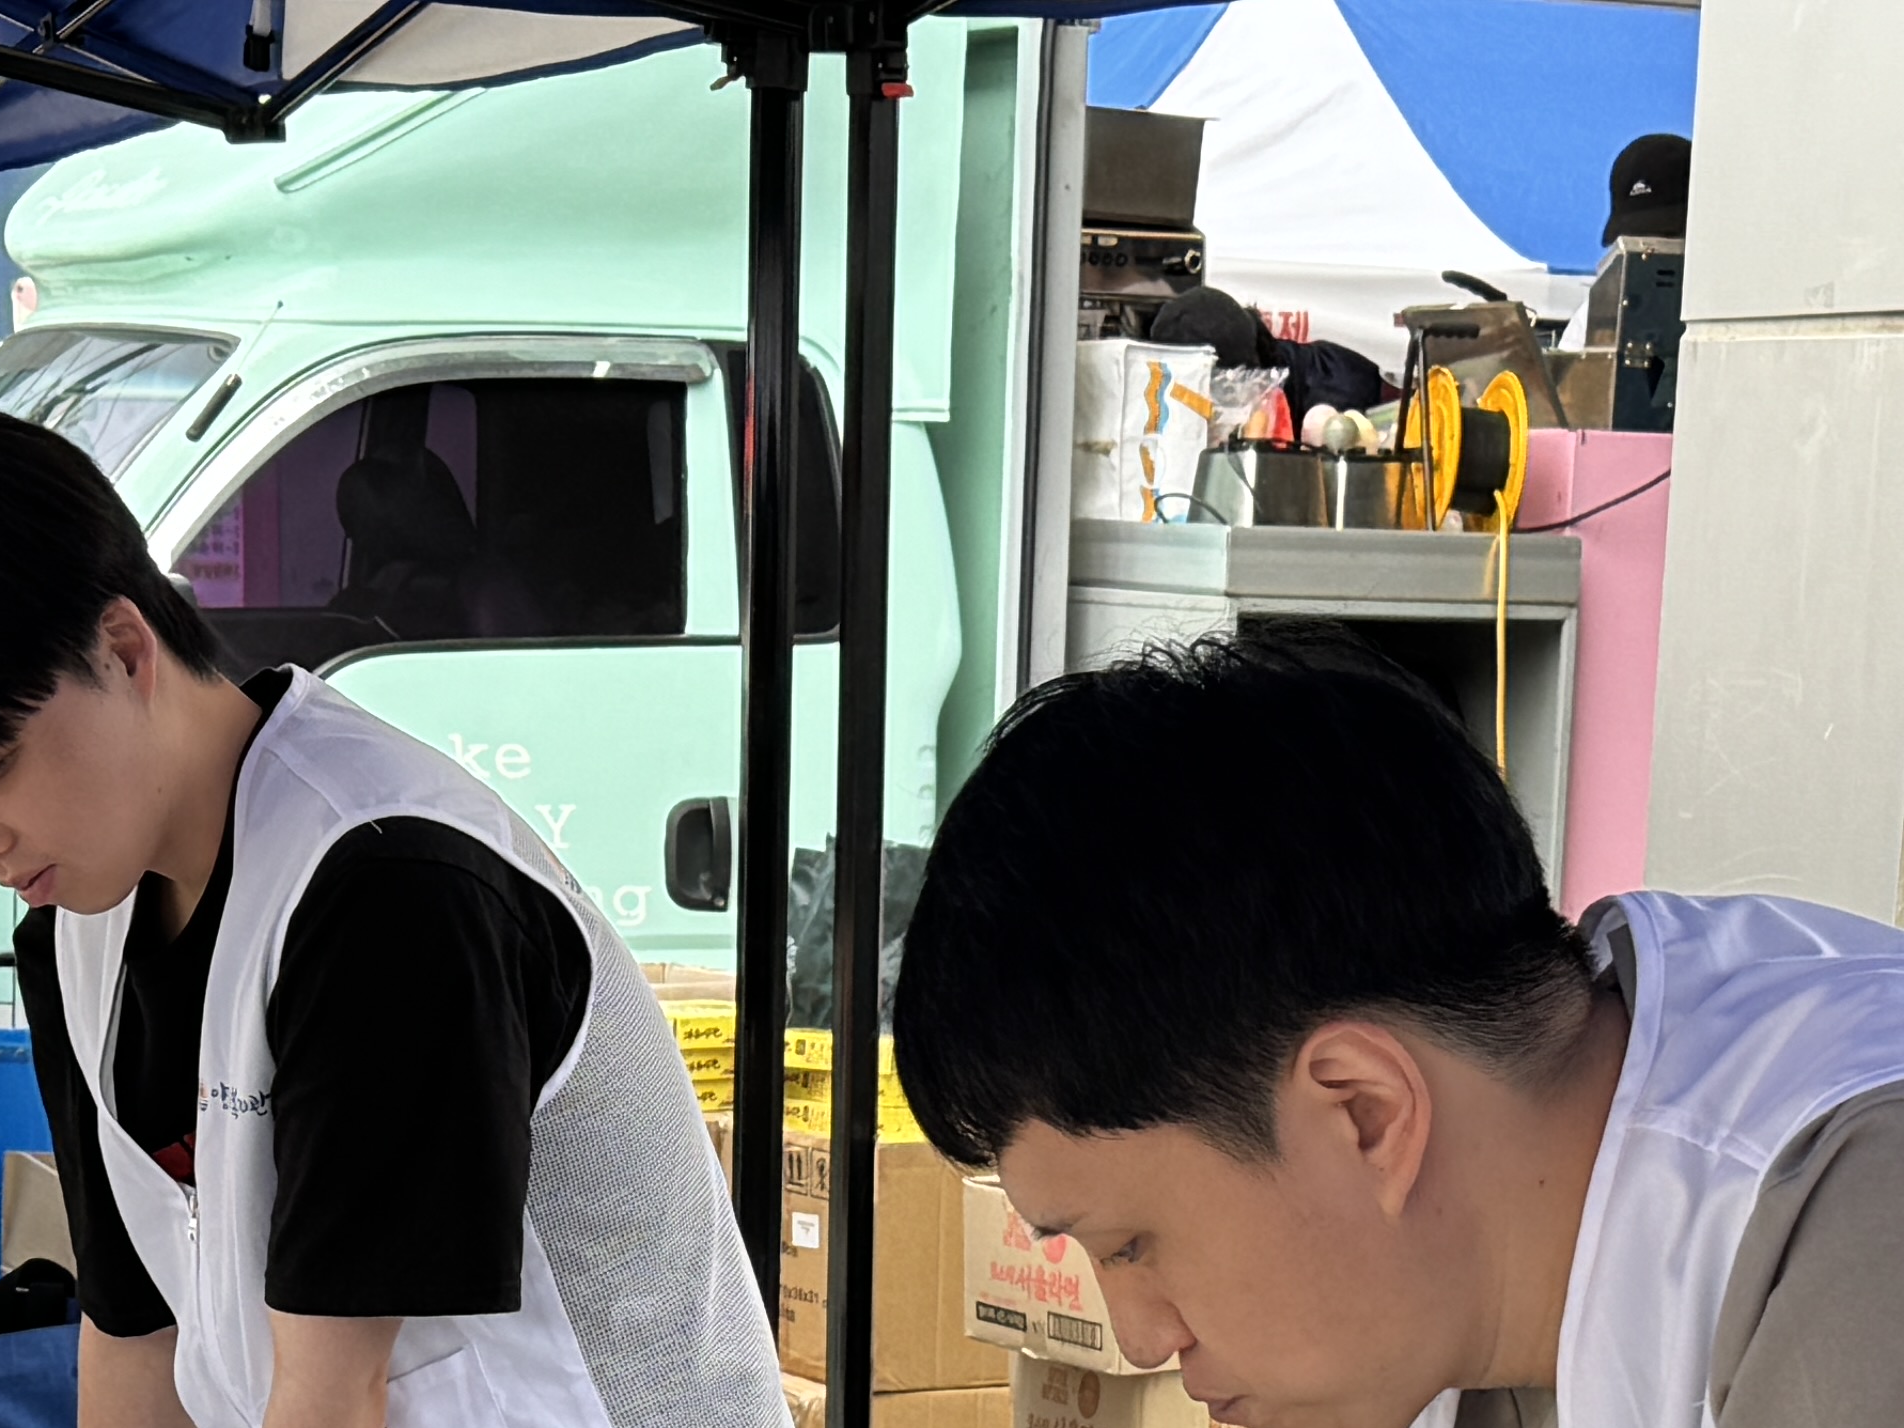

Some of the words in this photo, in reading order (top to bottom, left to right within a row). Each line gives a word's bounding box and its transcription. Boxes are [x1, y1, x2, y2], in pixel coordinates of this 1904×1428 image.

[448, 734, 532, 779] ke
[536, 804, 577, 849] Y
[593, 884, 653, 926] ng
